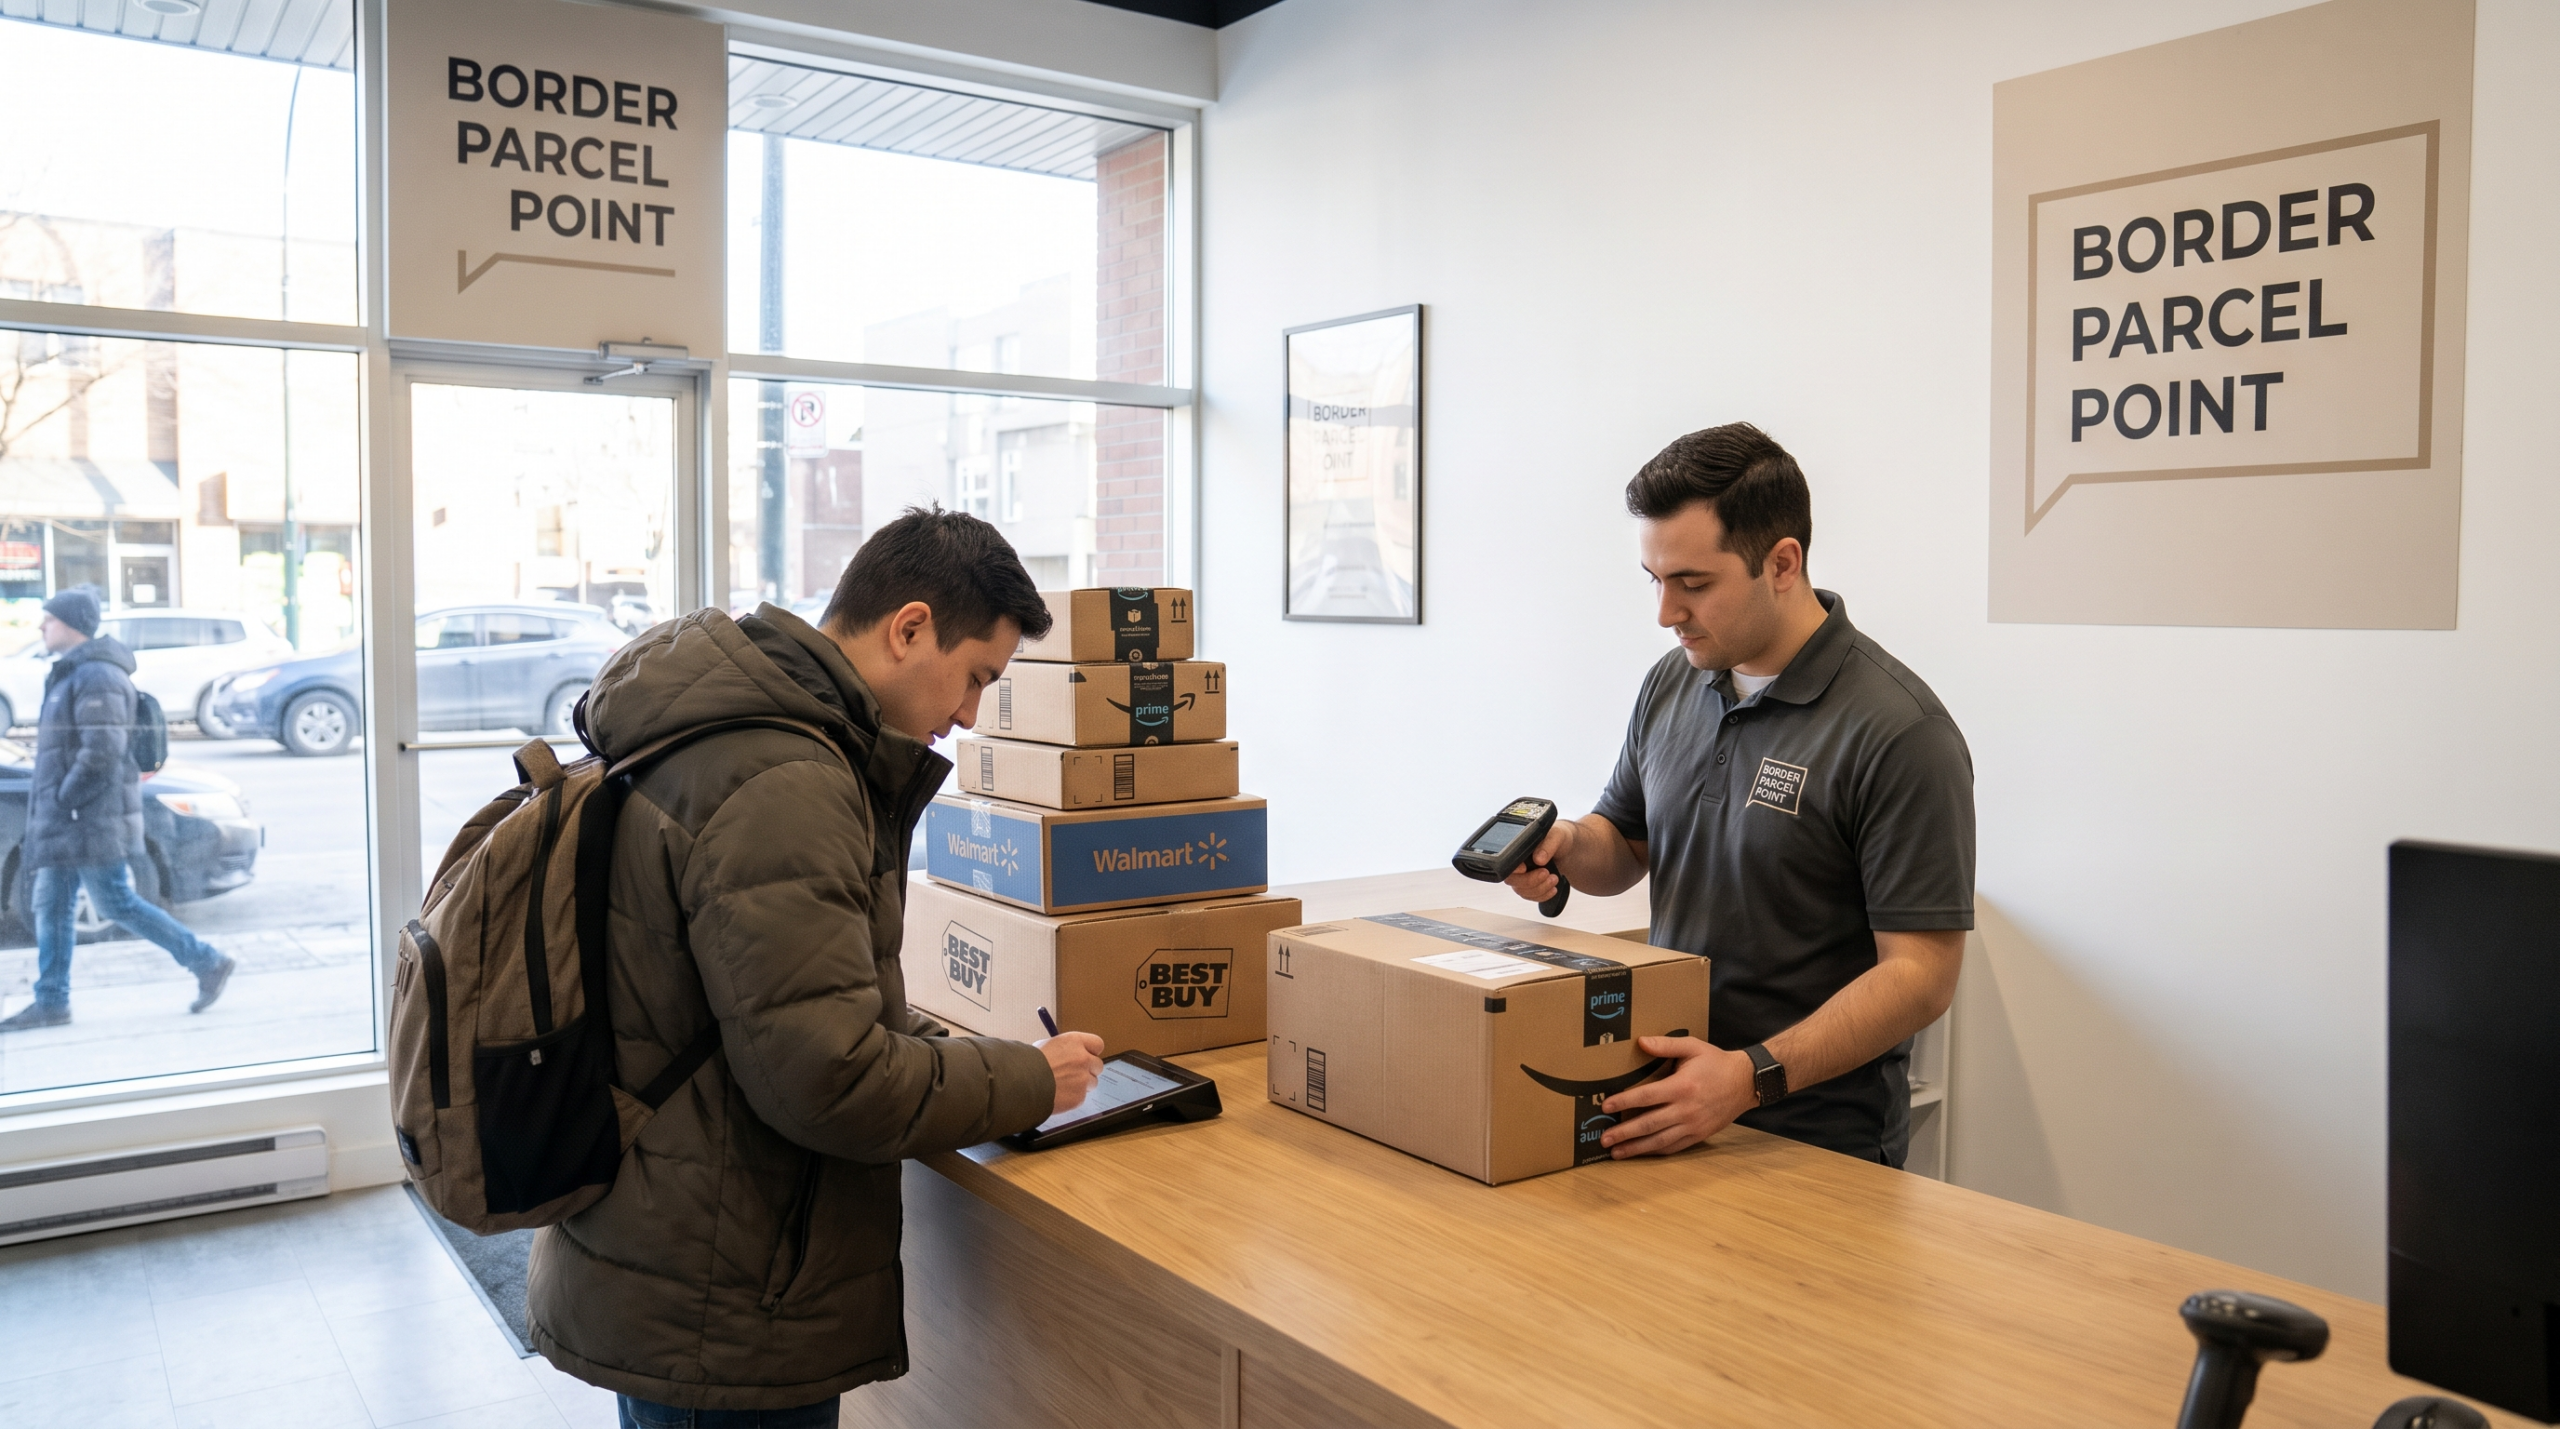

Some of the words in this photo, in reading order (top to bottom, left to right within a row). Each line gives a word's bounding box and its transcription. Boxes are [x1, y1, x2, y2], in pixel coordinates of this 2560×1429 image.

[448, 56, 678, 131] BORDER
[458, 120, 669, 188] PARCEL
[511, 189, 675, 246] POINT
[2073, 182, 2376, 281] BORDER
[2072, 278, 2348, 362] PARCEL
[1314, 405, 1367, 421] BORDER
[2071, 371, 2284, 443] POINT
[1322, 452, 1353, 470] OINT
[1135, 703, 1169, 718] prime
[1759, 776, 1795, 794] PARCEL
[1763, 764, 1800, 783] BORDER
[1755, 786, 1787, 803] POINT
[947, 832, 999, 867] Walmart
[1093, 842, 1193, 873] Walmart
[948, 933, 990, 974] BEST
[949, 956, 987, 995] BUY
[1149, 963, 1228, 985] BEST
[1151, 986, 1220, 1008] BUY
[1590, 991, 1626, 1010] prime
